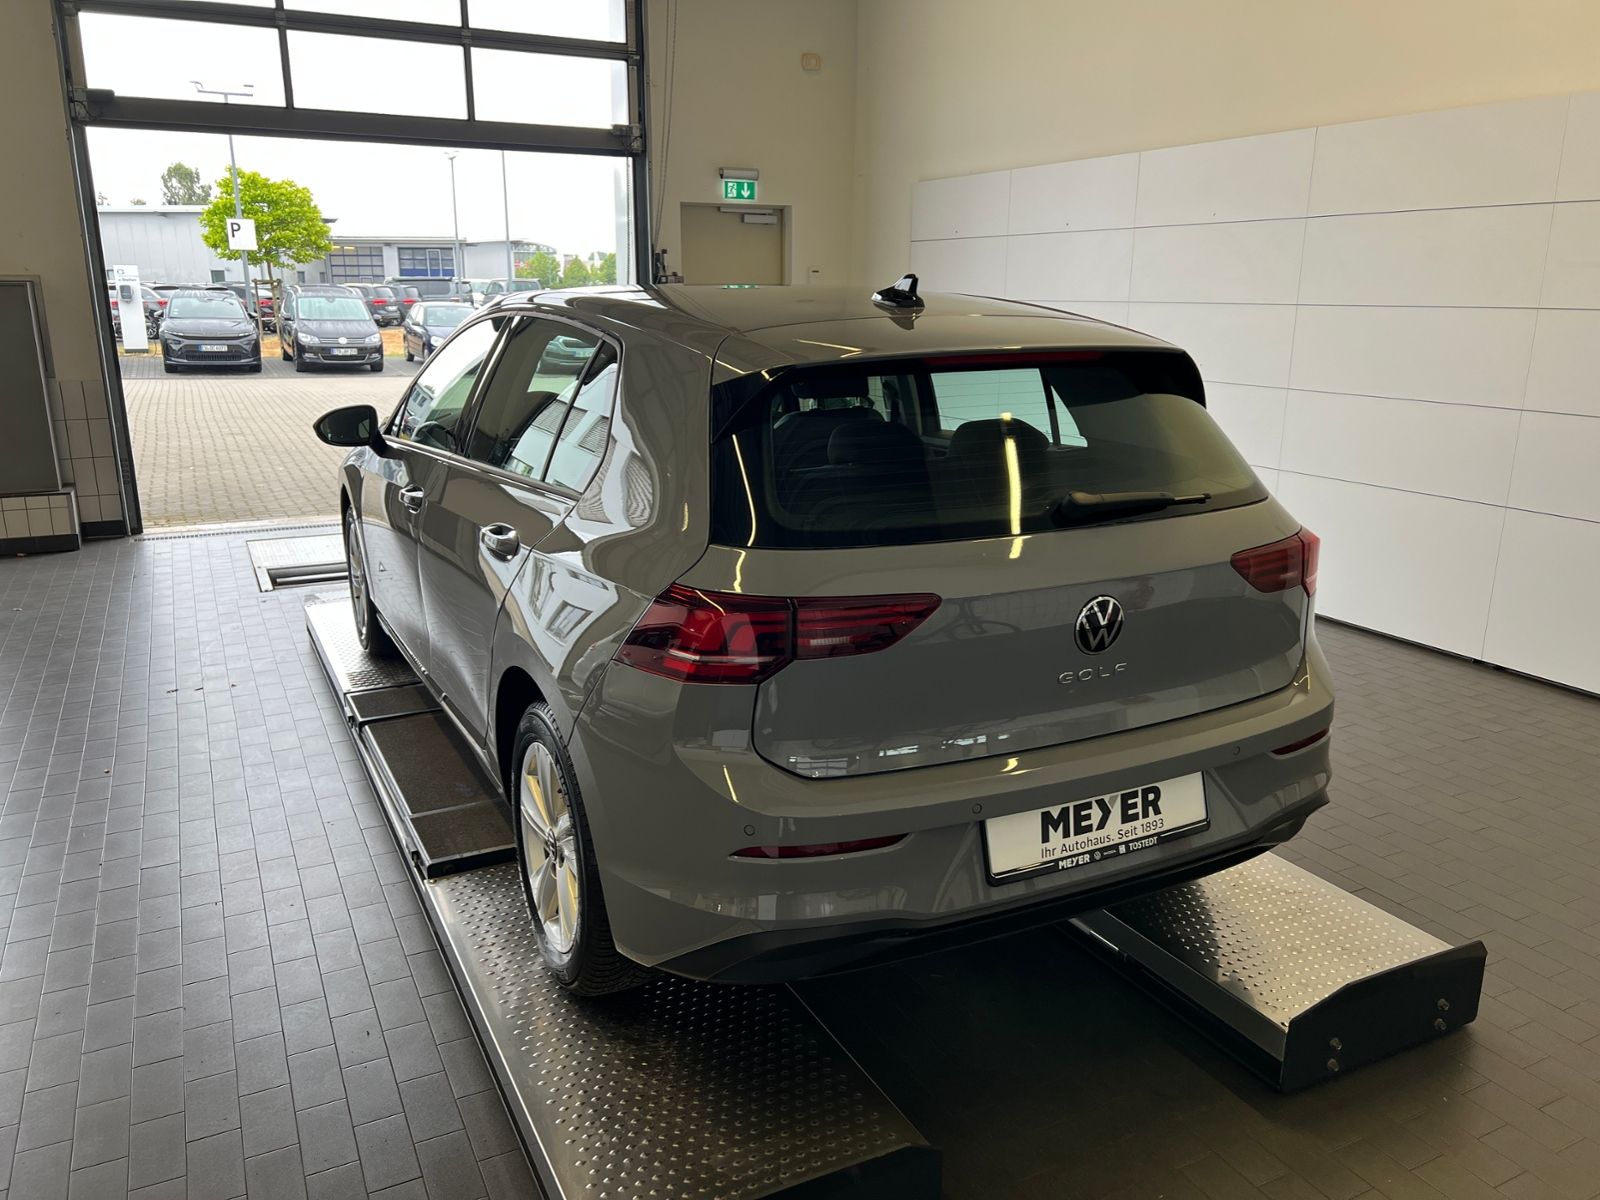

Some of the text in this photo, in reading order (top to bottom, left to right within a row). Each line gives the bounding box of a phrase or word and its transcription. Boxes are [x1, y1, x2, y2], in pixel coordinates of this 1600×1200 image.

[231, 222, 241, 238] P
[1058, 662, 1127, 684] GOLF
[1041, 785, 1162, 844] MEYER
[1041, 848, 1057, 859] Ihr
[1061, 835, 1115, 855] Autohaus.
[1118, 826, 1138, 840] Seit
[1141, 818, 1164, 834] 1893
[1058, 854, 1091, 869] MEYER
[1128, 836, 1158, 851] TOSTEDT
